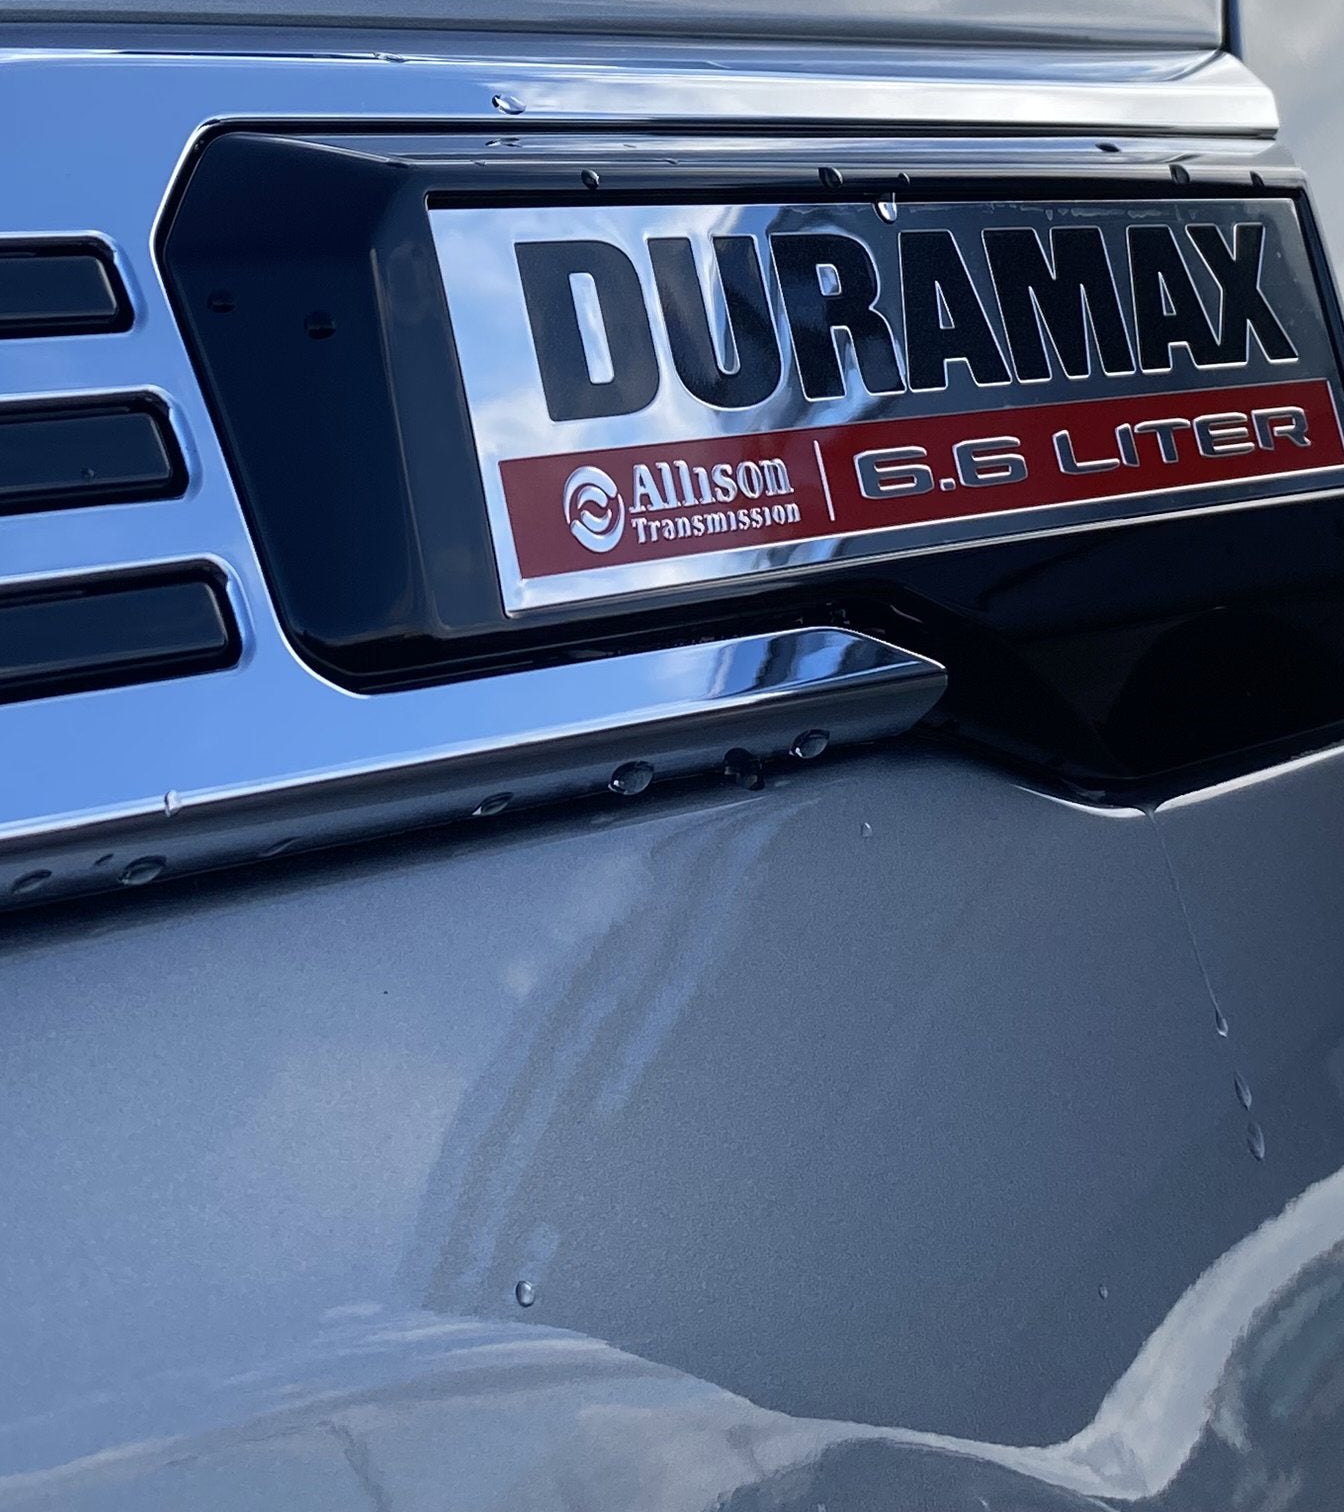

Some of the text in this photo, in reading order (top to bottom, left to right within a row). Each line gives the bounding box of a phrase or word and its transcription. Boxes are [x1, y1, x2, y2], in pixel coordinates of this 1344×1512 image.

[514, 223, 1299, 422] DURAMAX
[629, 457, 795, 514] Allison
[853, 405, 1312, 500] 6.6 LITER
[631, 501, 801, 544] Transmission
